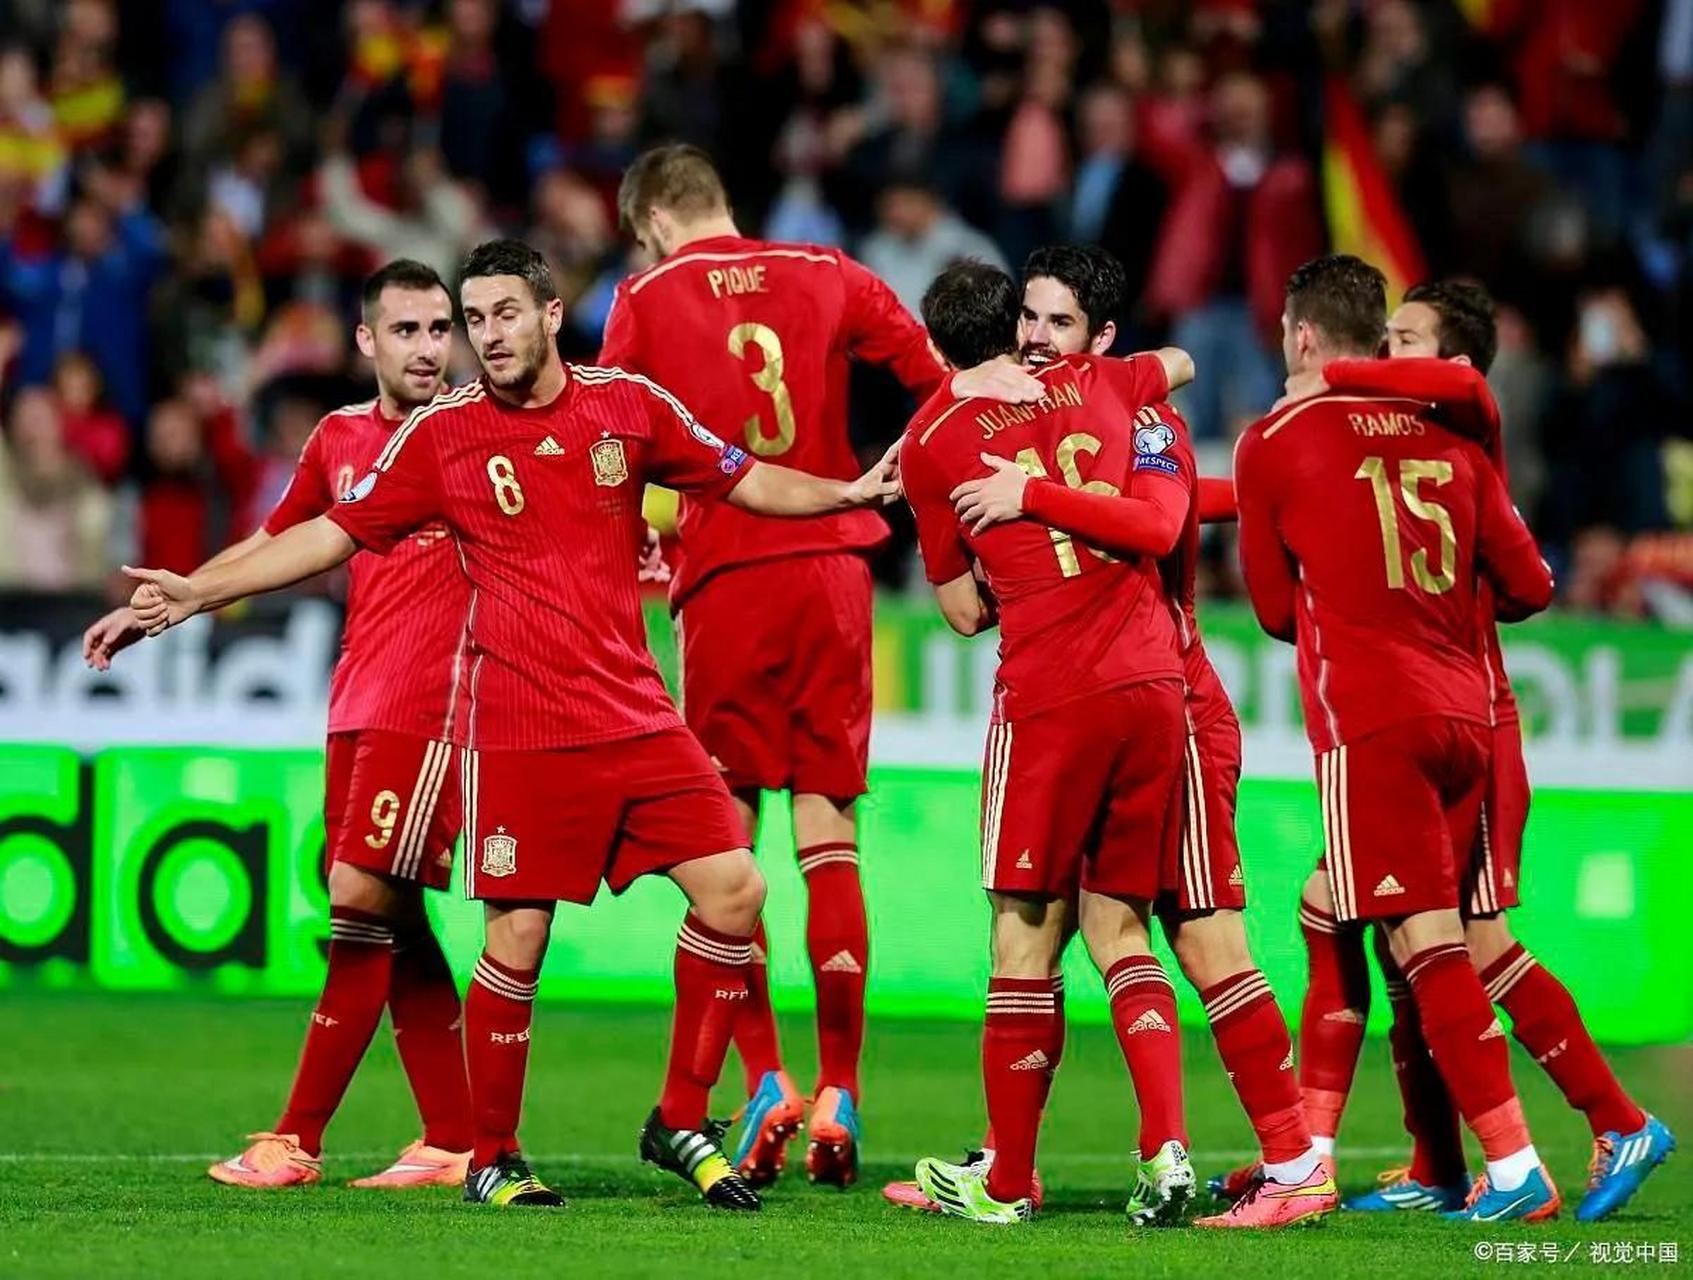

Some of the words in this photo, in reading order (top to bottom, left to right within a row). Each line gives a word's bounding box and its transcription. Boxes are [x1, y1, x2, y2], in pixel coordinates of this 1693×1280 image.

[707, 265, 769, 299] PIQUE
[727, 322, 796, 456] 3
[1348, 412, 1425, 436] RAMOS
[486, 455, 525, 516] 8
[1139, 456, 1179, 472] RESPECT
[1354, 456, 1457, 595] 15
[364, 789, 400, 849] 9
